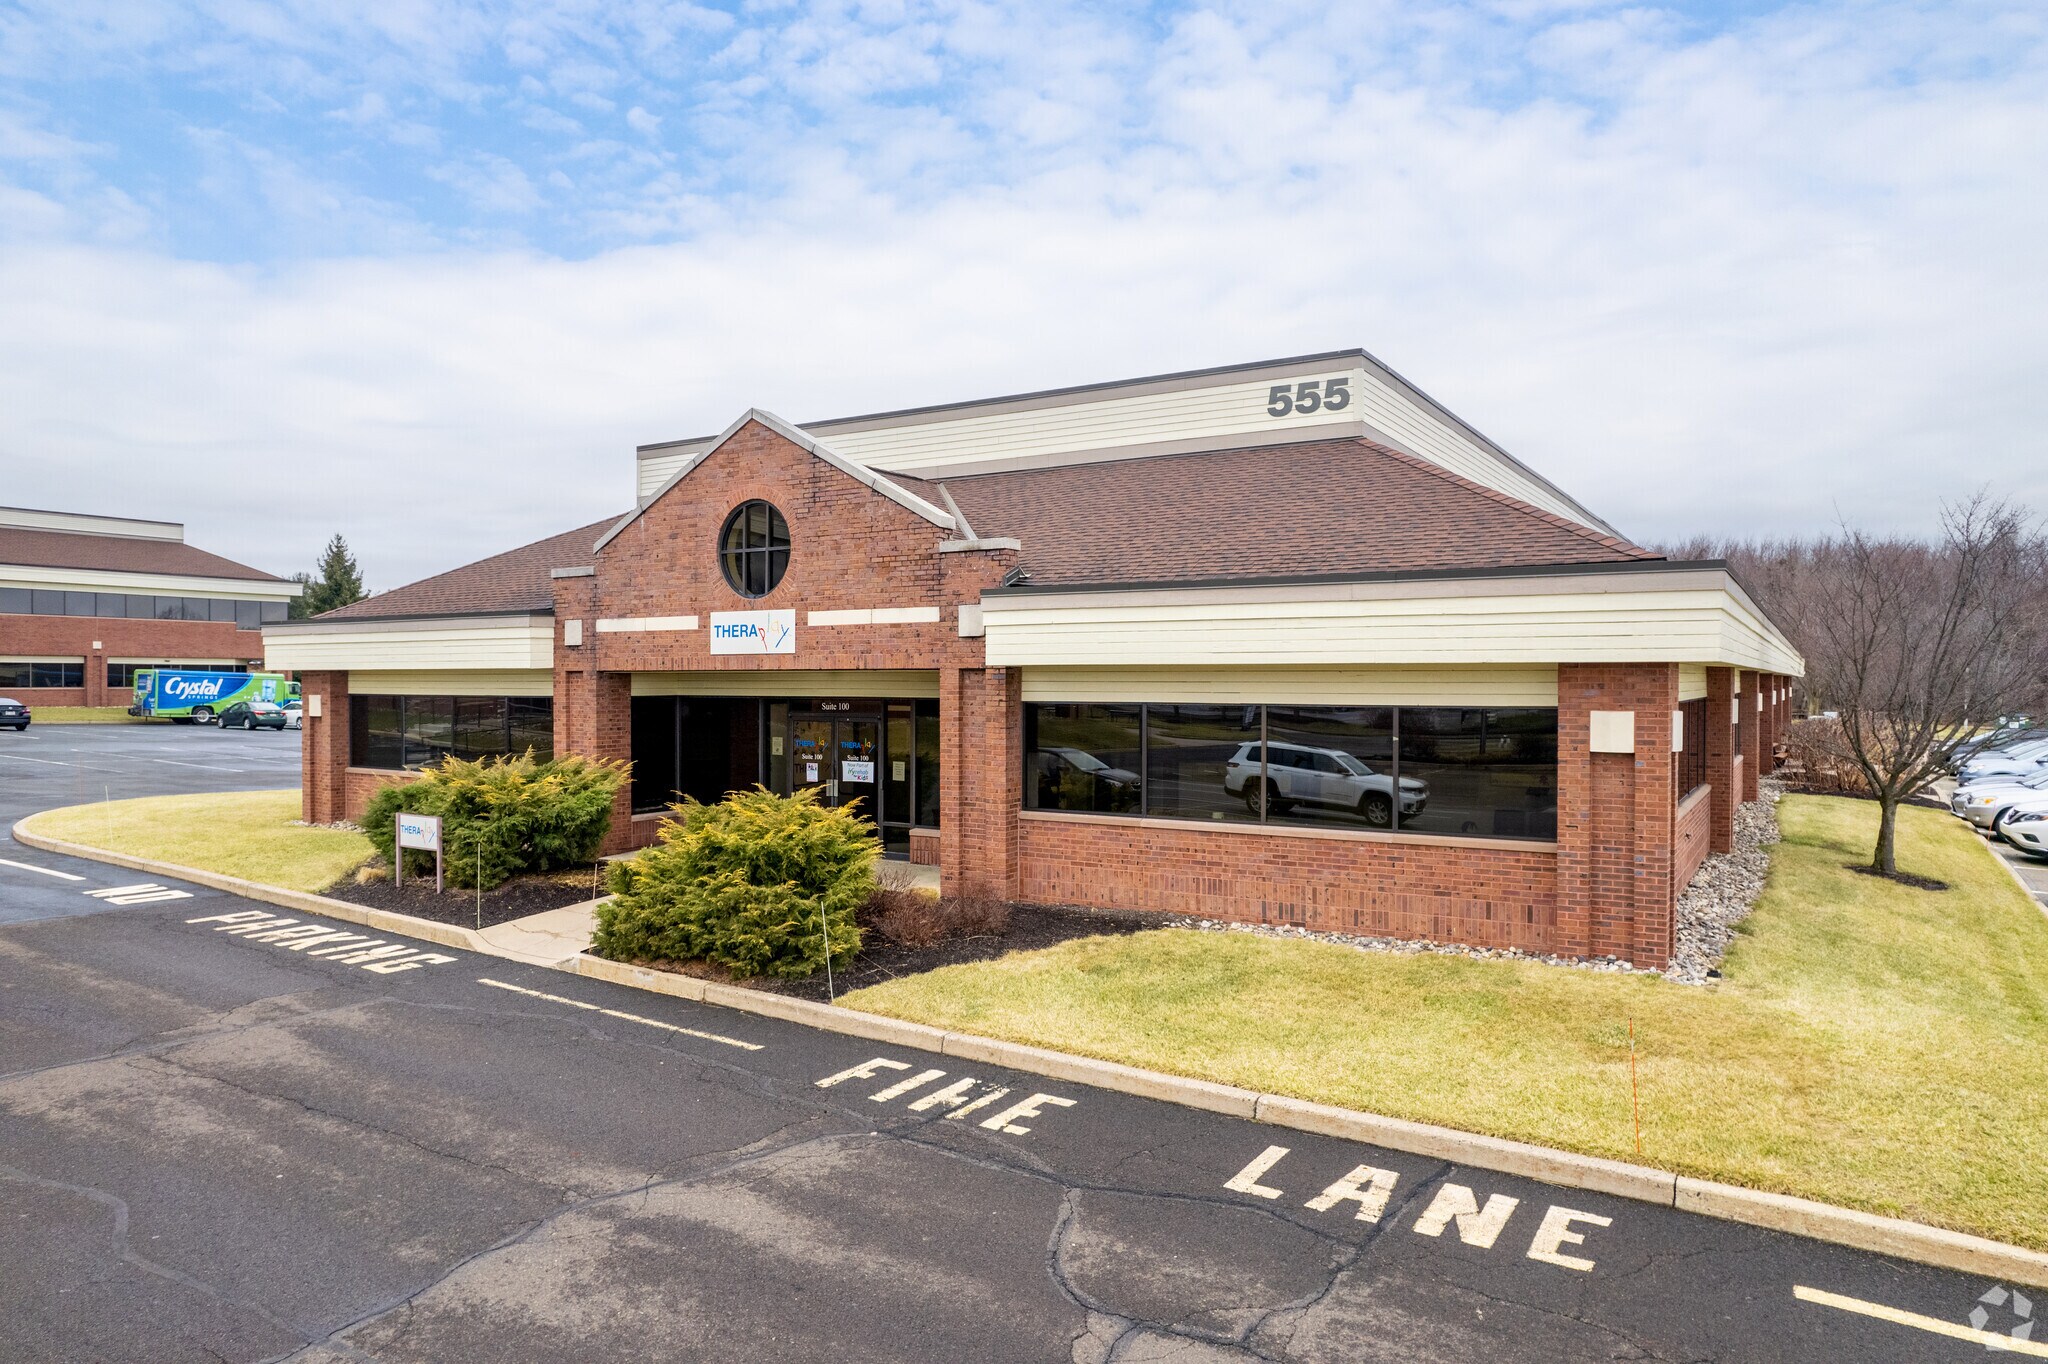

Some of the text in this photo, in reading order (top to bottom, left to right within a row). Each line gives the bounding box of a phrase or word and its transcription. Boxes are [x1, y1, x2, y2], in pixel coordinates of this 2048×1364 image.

[1267, 377, 1350, 418] 555
[165, 677, 223, 700] Crystal
[821, 702, 850, 711] Suite 100
[82, 883, 459, 975] NO PARKING
[1223, 1145, 1613, 1272] LANE
